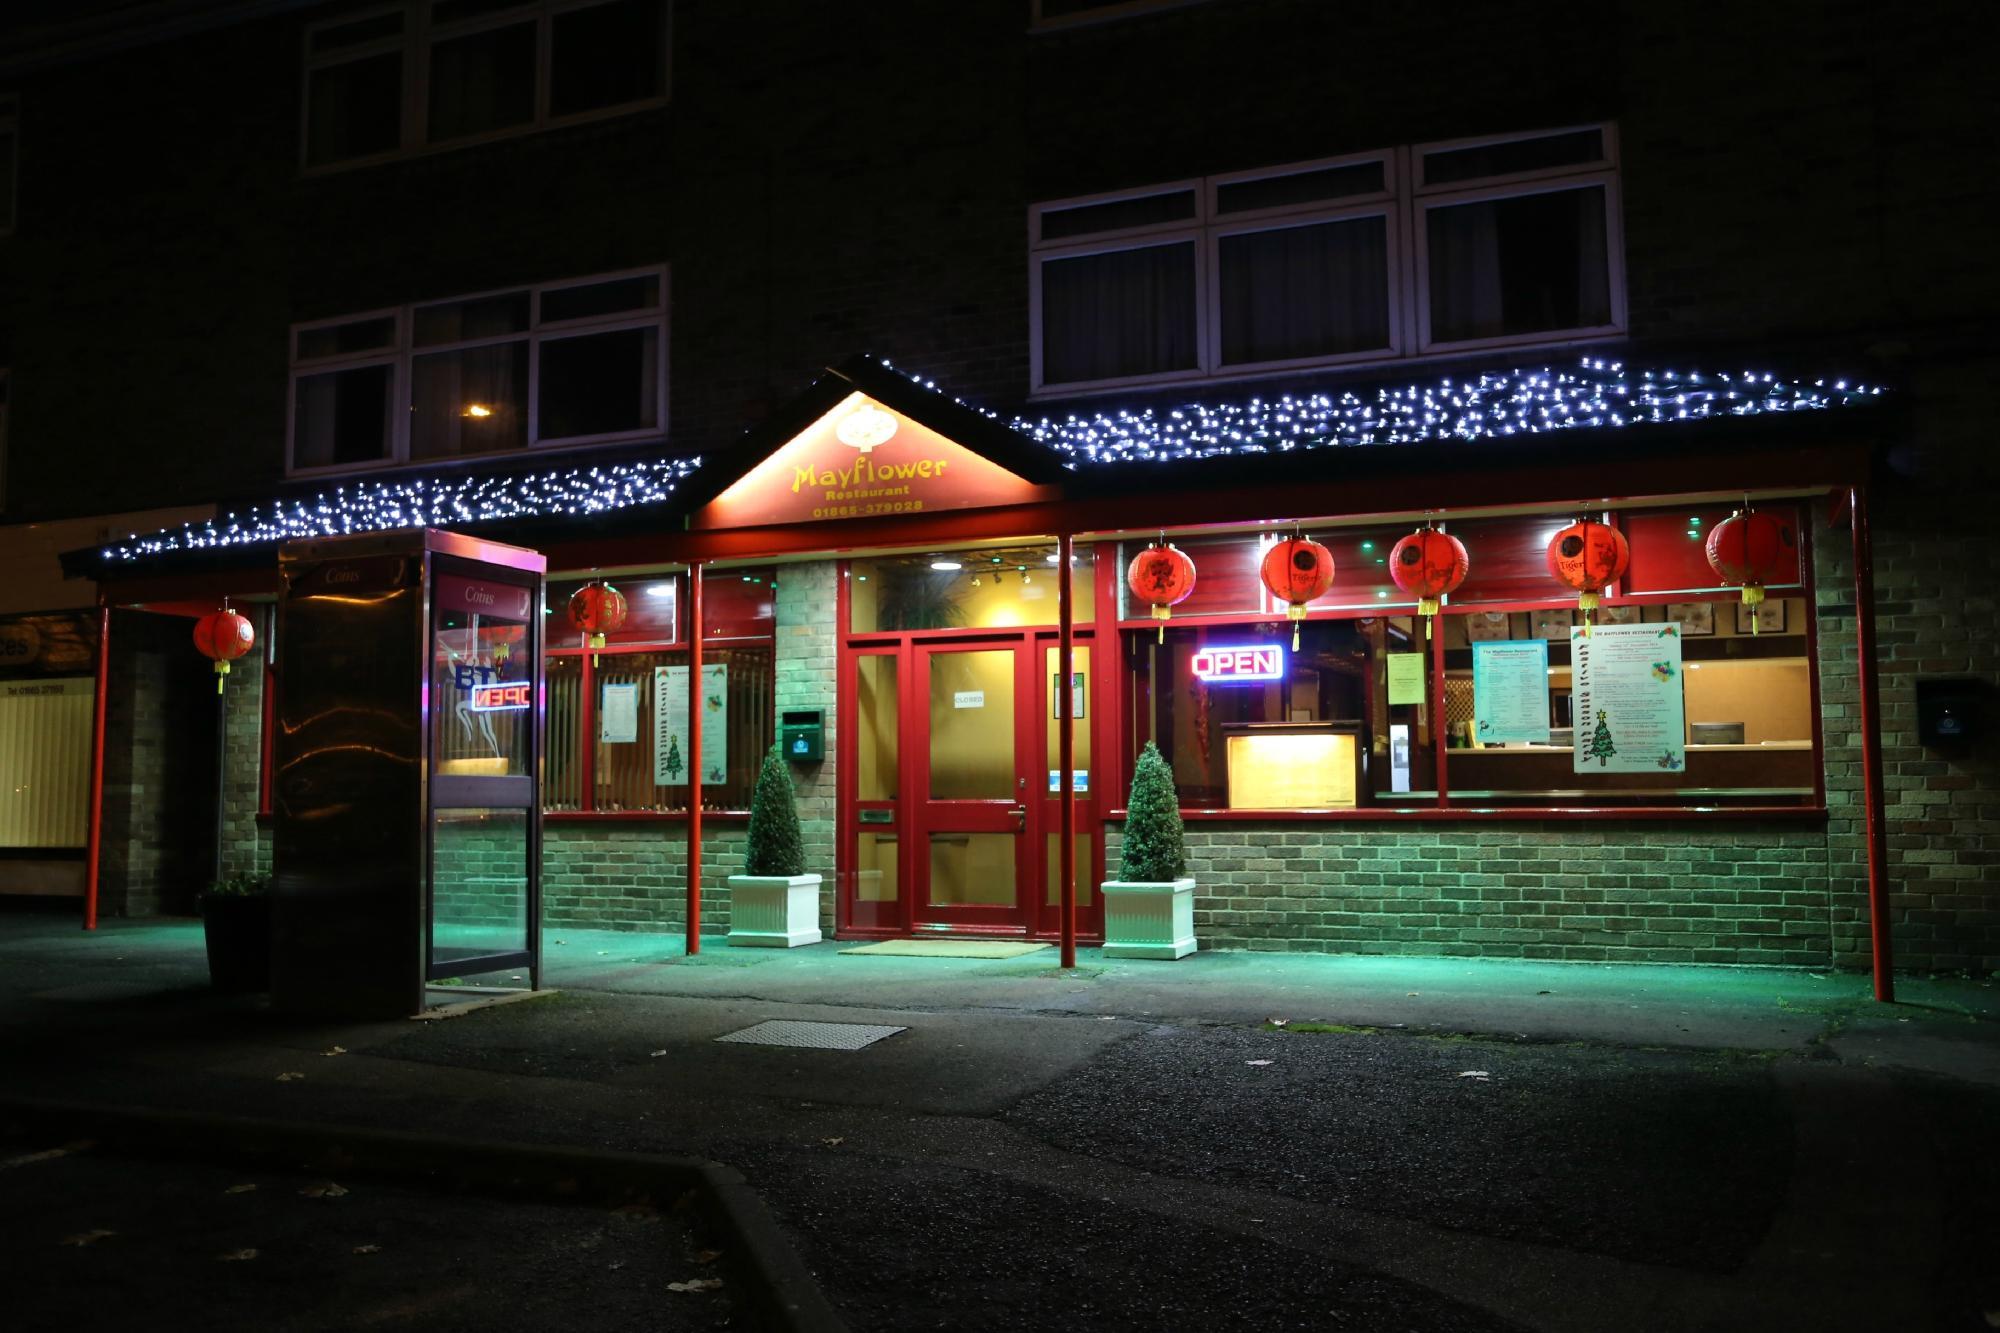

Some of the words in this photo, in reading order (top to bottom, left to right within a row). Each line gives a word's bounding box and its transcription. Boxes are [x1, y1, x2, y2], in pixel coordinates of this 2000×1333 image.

[792, 456, 948, 493] Mayflower
[826, 485, 910, 501] Restaurant
[812, 500, 923, 518] 01865-379028
[325, 565, 360, 584] Coins
[1560, 560, 1585, 572] Tiger
[464, 586, 495, 605] Coins
[1191, 651, 1276, 677] OPEN
[456, 665, 496, 690] BT
